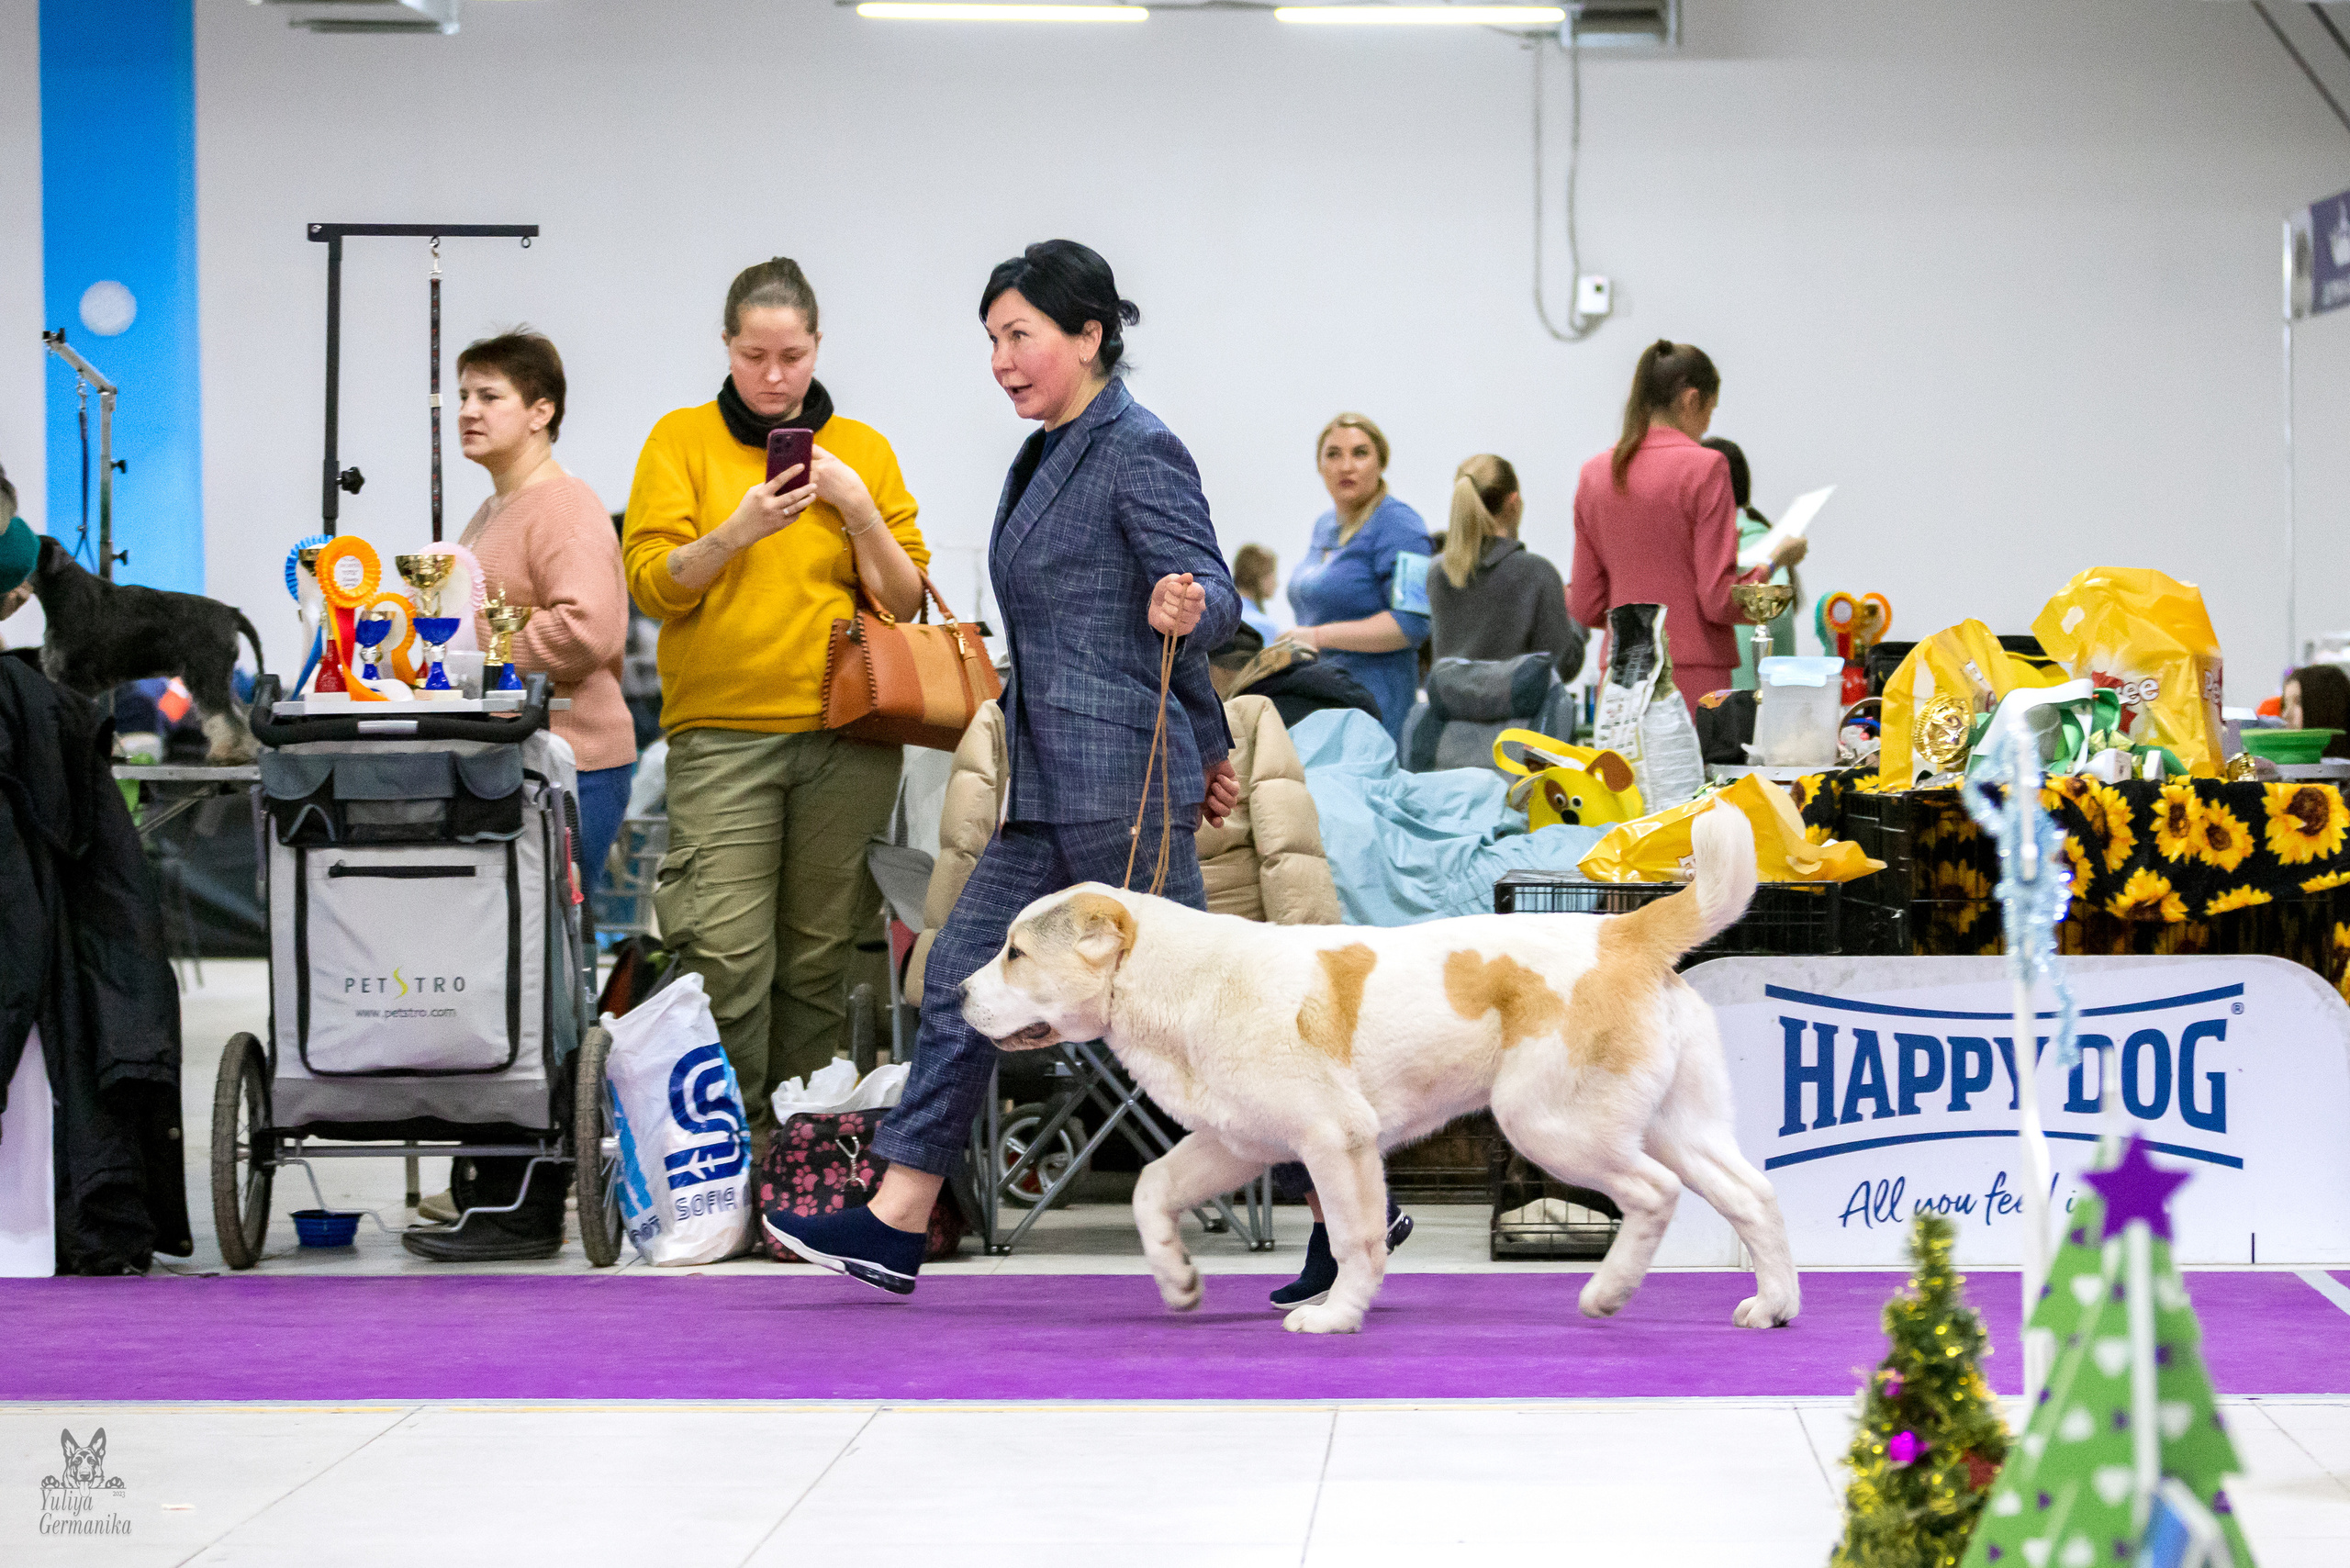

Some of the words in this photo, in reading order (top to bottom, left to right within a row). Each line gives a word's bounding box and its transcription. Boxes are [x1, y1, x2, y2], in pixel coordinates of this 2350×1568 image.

[344, 965, 465, 1000] PETSTRO
[355, 1008, 457, 1021] www.petstro.com
[1778, 1015, 2050, 1137] HAPPY
[675, 1186, 737, 1222] SOFIA
[1838, 1176, 1907, 1229] All
